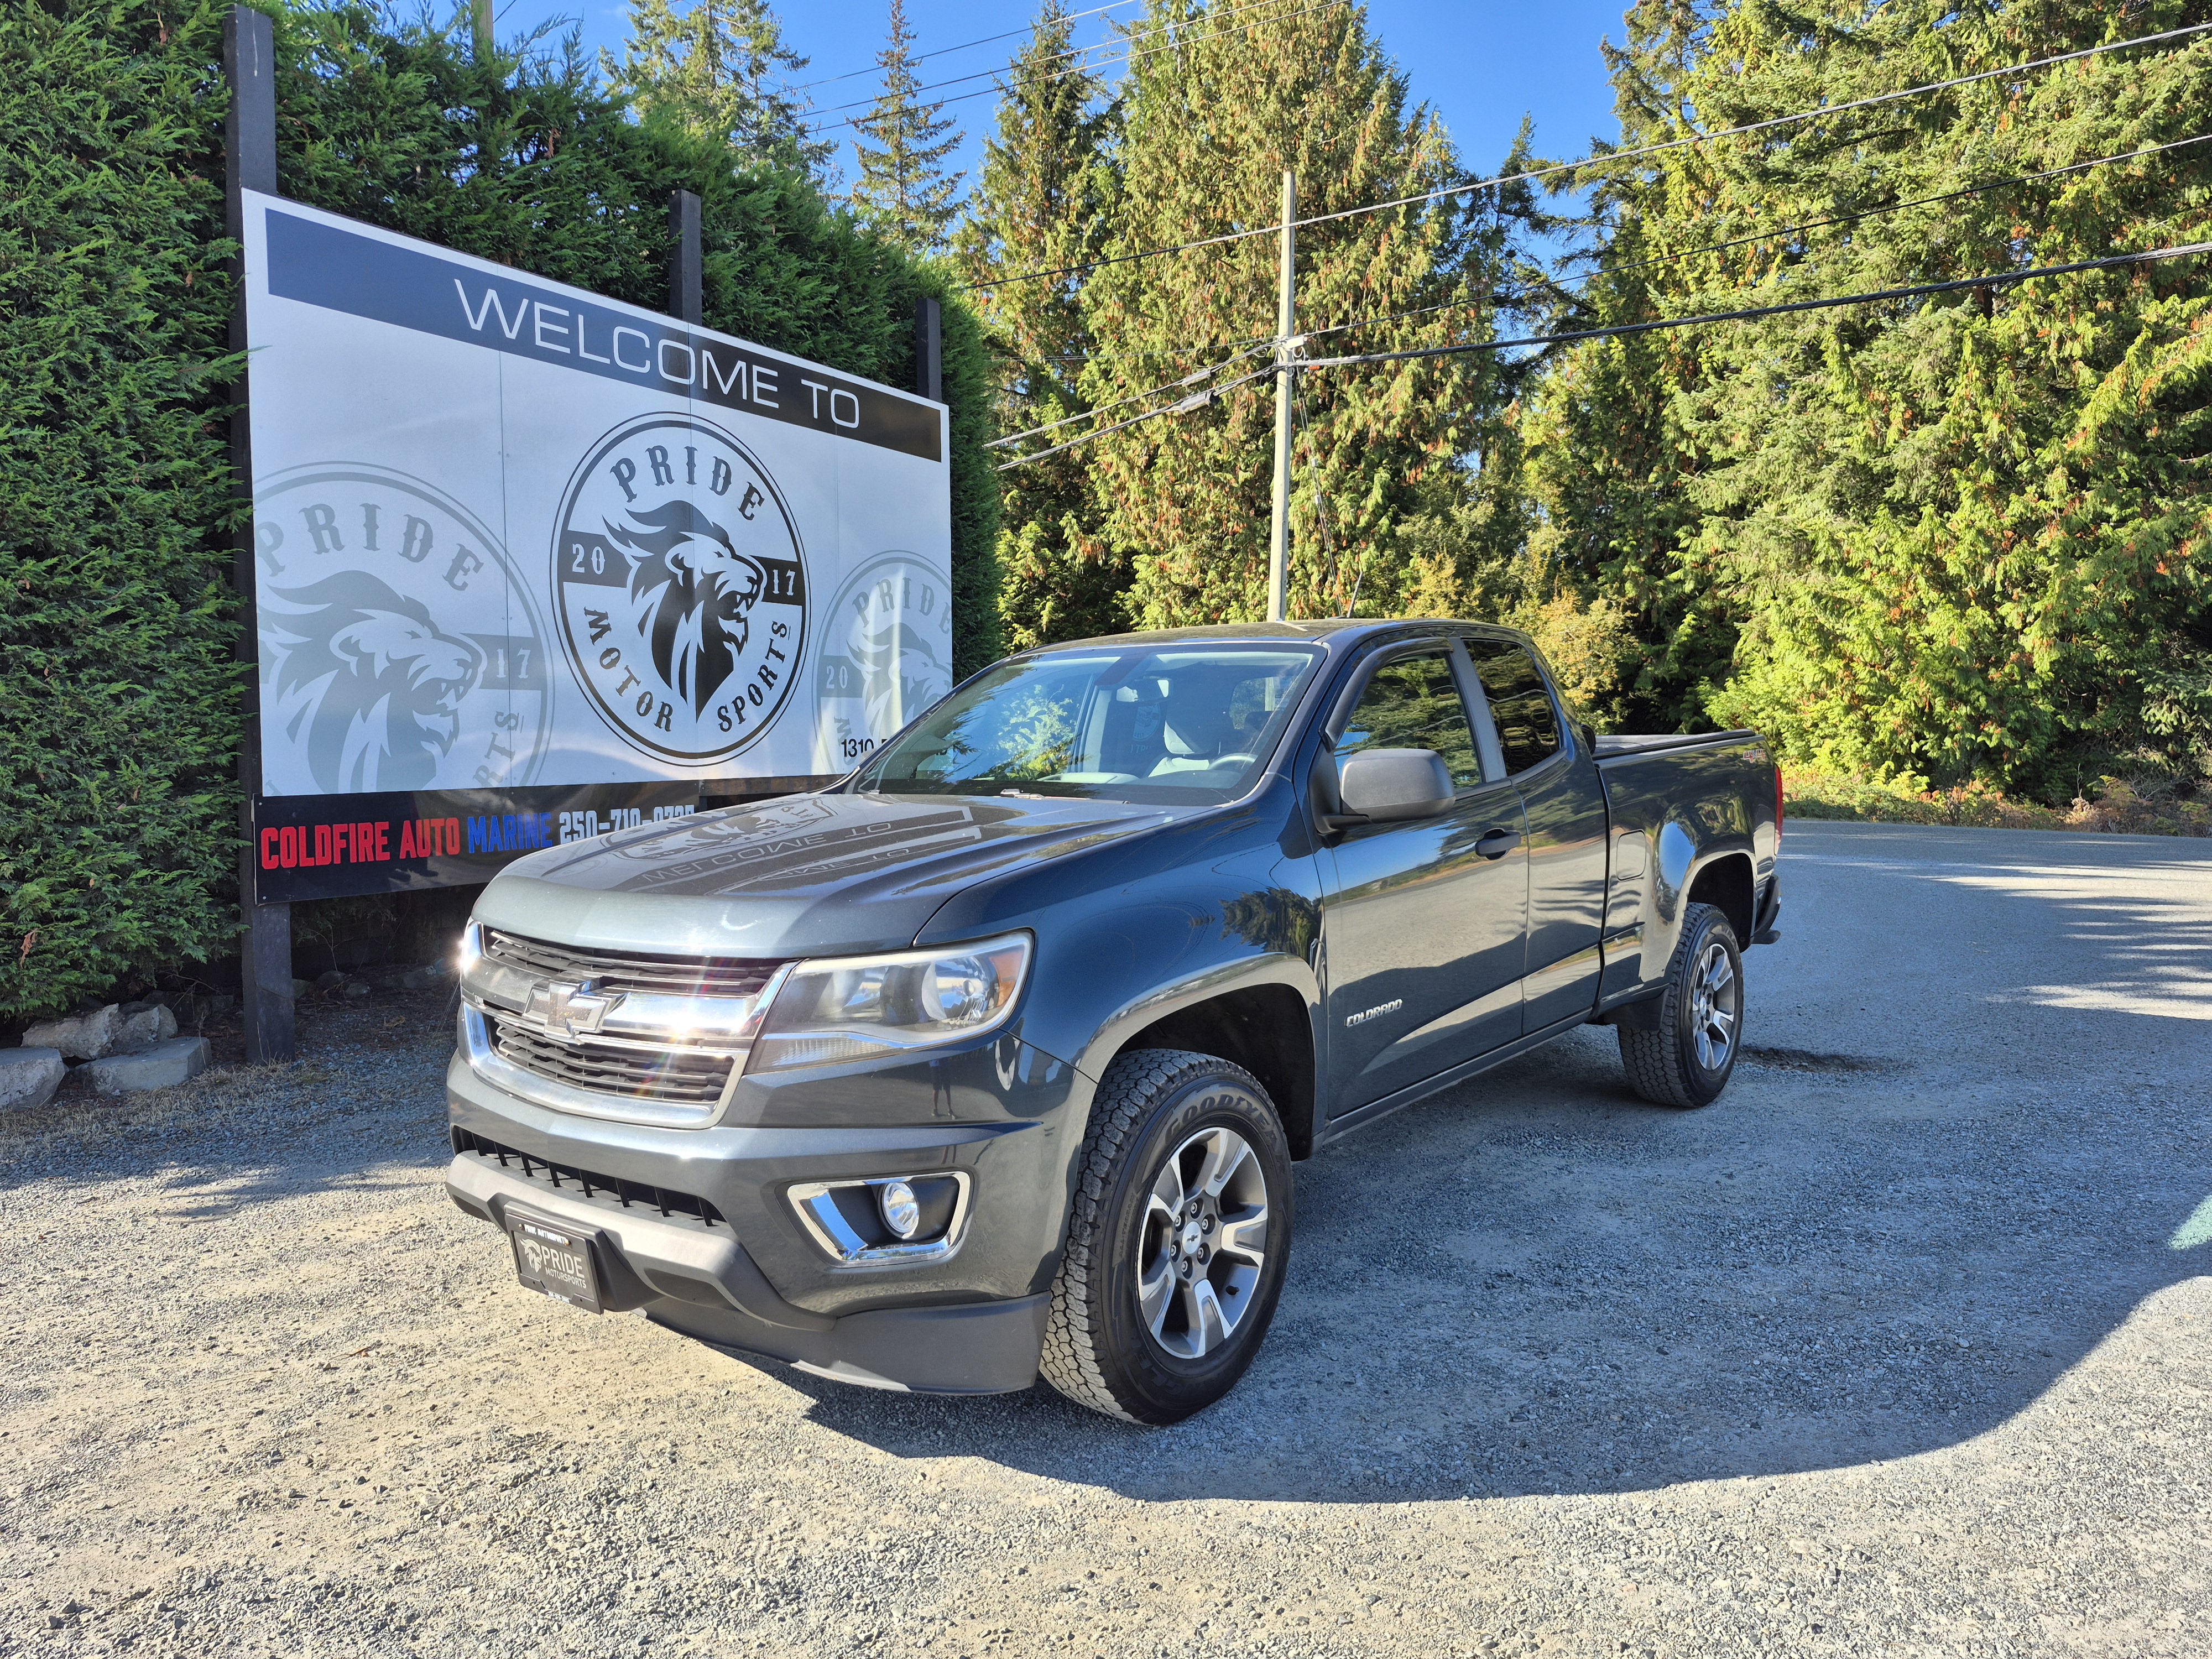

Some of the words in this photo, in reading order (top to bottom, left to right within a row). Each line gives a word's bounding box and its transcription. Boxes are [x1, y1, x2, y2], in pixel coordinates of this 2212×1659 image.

[454, 278, 779, 409] WELCOME
[801, 378, 859, 429] TO
[610, 445, 765, 521] PRIDE
[255, 502, 484, 592] PRIDE
[571, 542, 606, 575] 20
[772, 568, 796, 596] 17
[495, 648, 530, 680] 17
[583, 606, 674, 733] MOTOR
[717, 620, 789, 733] SPORTS
[826, 665, 849, 690] 20
[841, 738, 874, 758] 1310
[260, 821, 390, 870] COLDFIRE
[398, 817, 461, 859] AUTO
[467, 812, 554, 854] MARINE
[1344, 998, 1403, 1028] COLORADO
[541, 1245, 585, 1278] PRIDE
[545, 1266, 587, 1289] MOTORSPORTS
